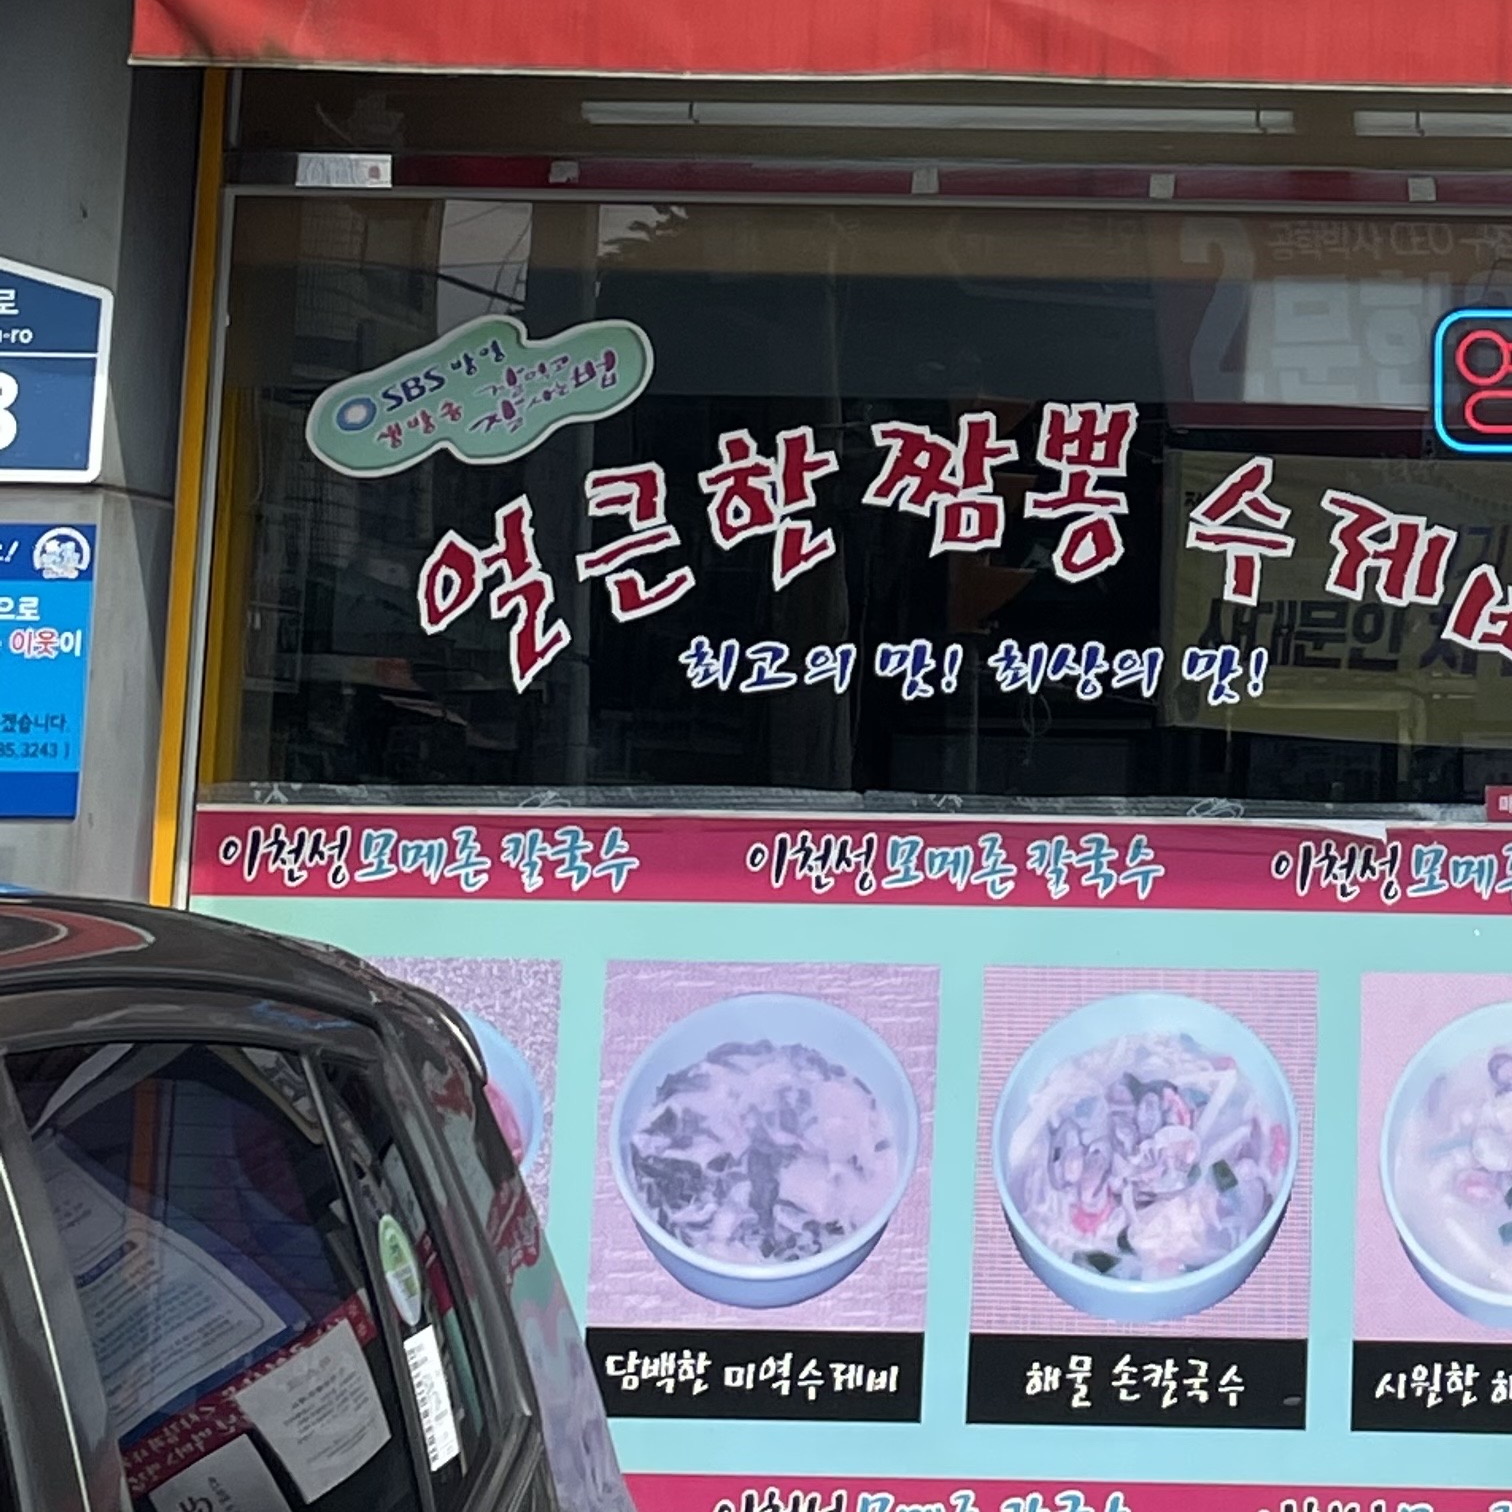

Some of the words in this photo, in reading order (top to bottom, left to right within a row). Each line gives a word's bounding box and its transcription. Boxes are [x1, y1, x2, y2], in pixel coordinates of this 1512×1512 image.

[381, 366, 446, 413] SBS
[417, 427, 839, 692] 얼큰한
[862, 403, 1139, 583] 짬뽕
[680, 636, 857, 694] 최고의
[875, 640, 963, 700] 맛!
[988, 639, 1164, 700] 최상의
[1182, 644, 1270, 707] 맛!
[220, 826, 349, 890] 이천성
[354, 827, 492, 893] 모메존
[501, 828, 640, 893] 칼국수
[748, 831, 875, 895] 이천성
[886, 834, 1020, 898] 모메존
[1026, 835, 1165, 900] 칼국수
[1272, 839, 1401, 904] 이천성
[605, 1350, 711, 1397] 담백한
[724, 1357, 900, 1401] 미역수제비
[1026, 1355, 1093, 1411] 해물
[1112, 1354, 1246, 1407] 손칼국수
[1375, 1360, 1478, 1407] 시원한
